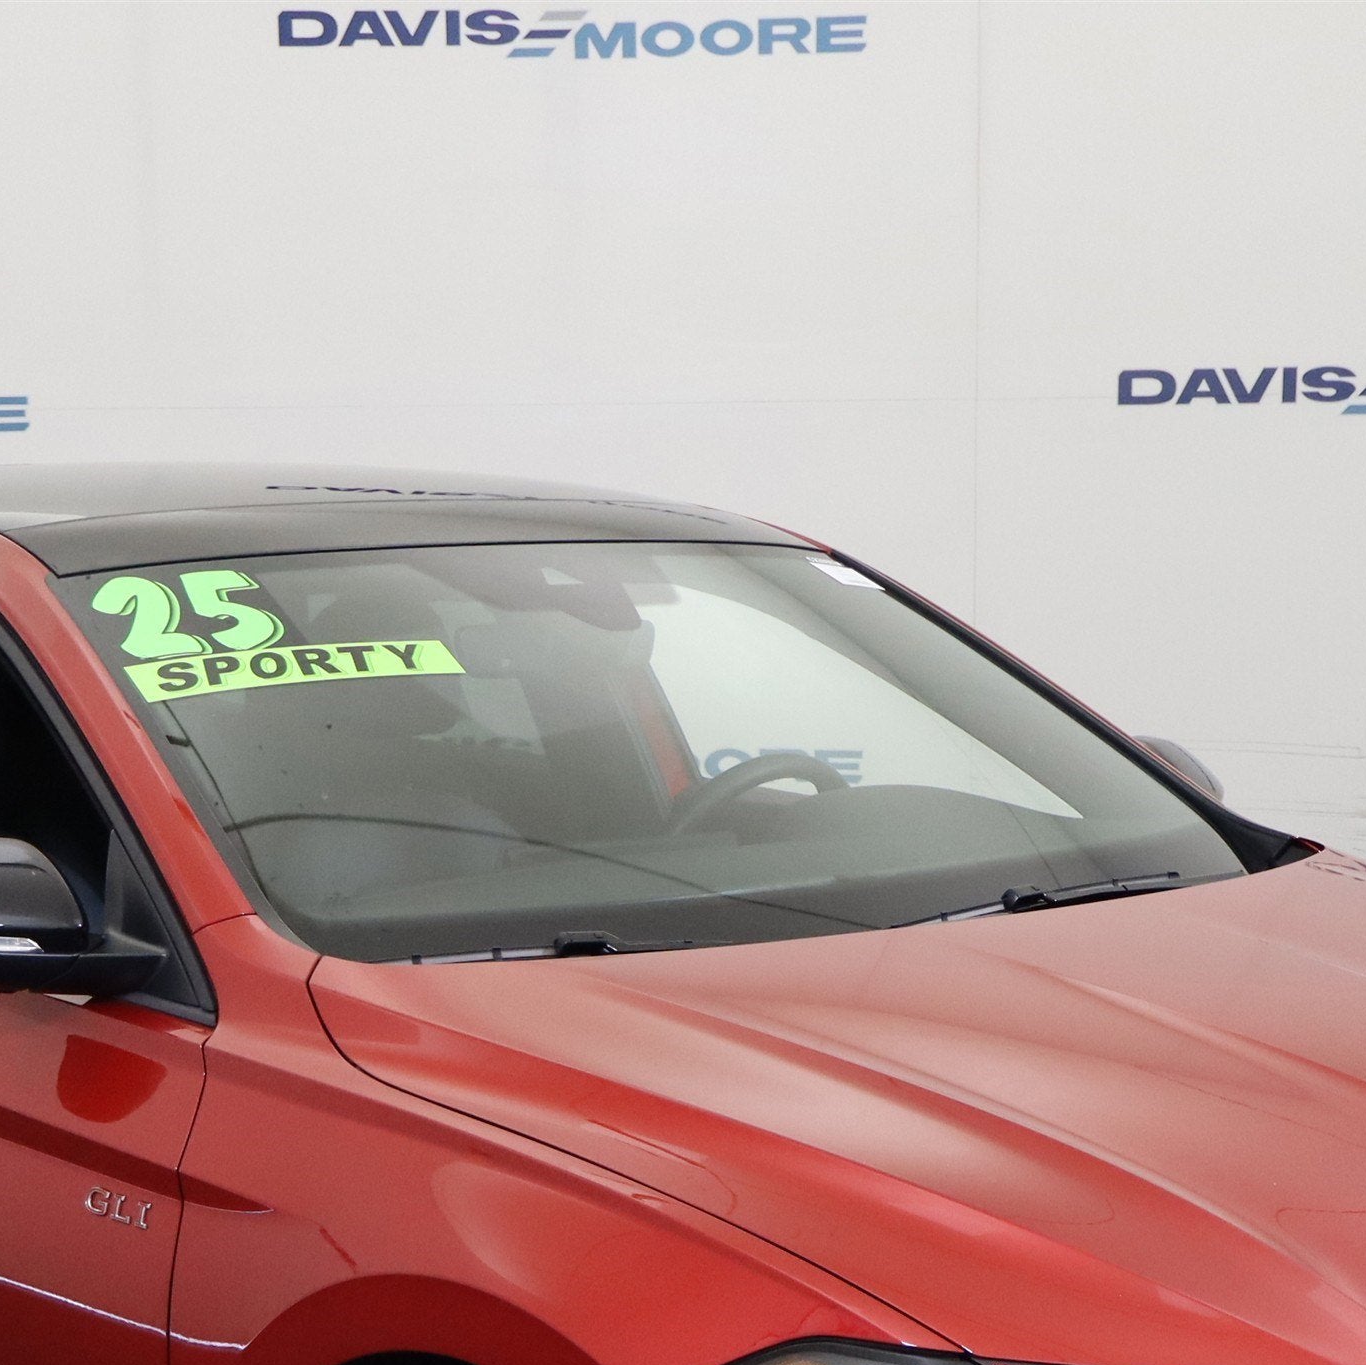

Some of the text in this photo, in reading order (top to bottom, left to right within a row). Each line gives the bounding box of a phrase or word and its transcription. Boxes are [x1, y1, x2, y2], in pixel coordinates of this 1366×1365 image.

[278, 9, 868, 61] DAVIS MOORE
[1118, 365, 1357, 406] DAVIS
[91, 570, 285, 660] 25
[156, 643, 418, 693] SPORTY
[84, 1186, 153, 1231] GLI
